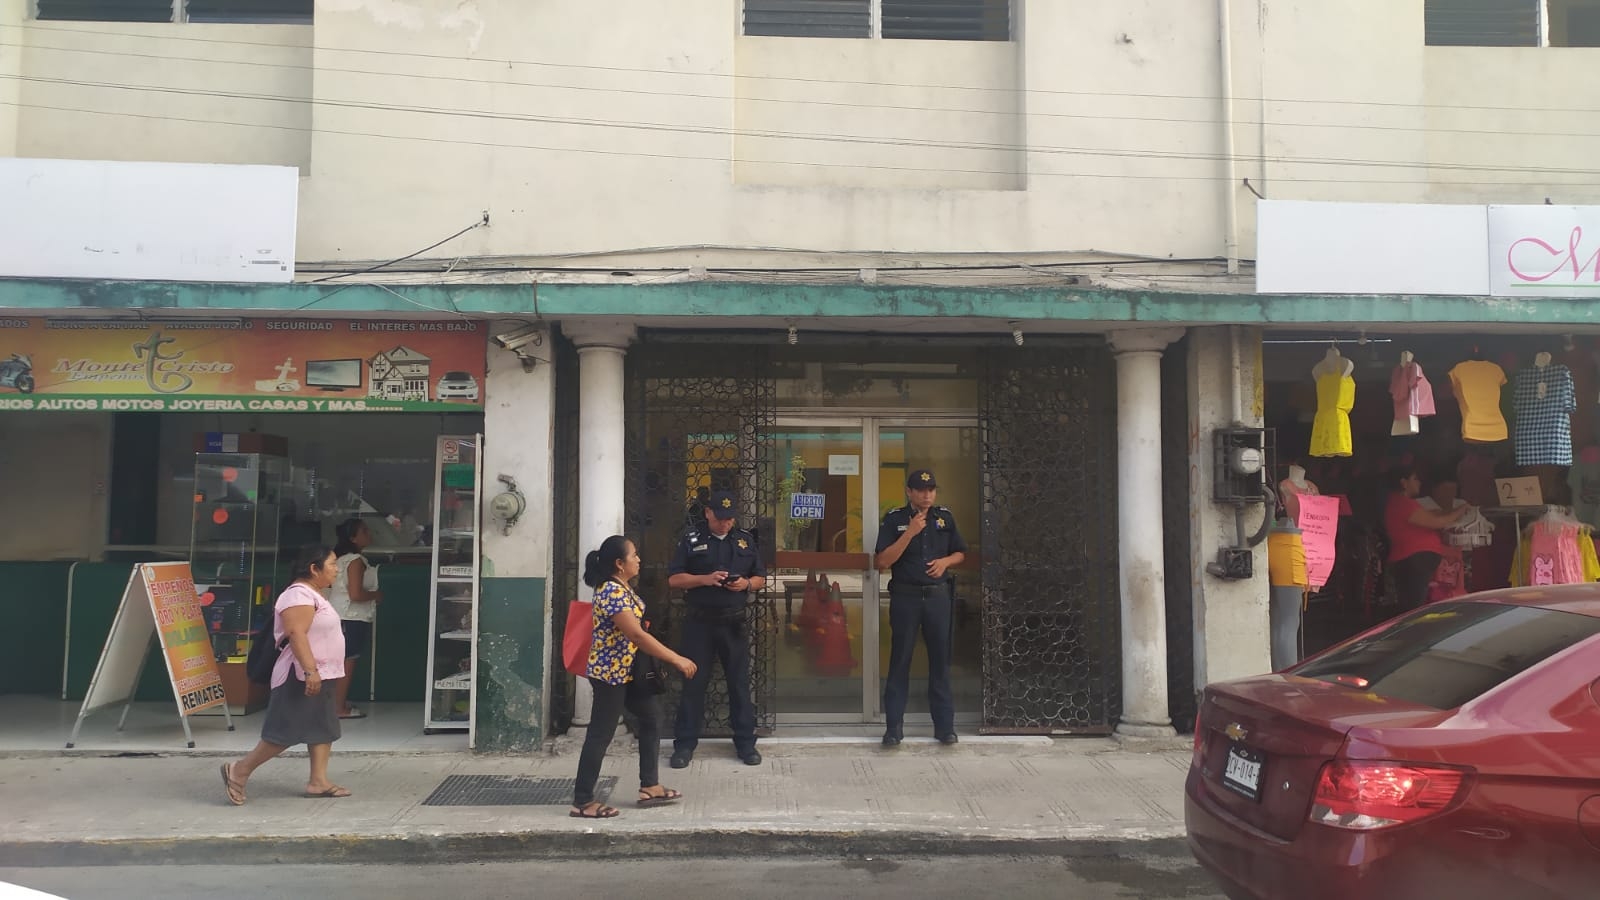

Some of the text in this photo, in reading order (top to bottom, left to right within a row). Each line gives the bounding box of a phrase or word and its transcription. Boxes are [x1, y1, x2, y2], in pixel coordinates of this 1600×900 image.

[350, 323, 476, 331] EL INTERES MAS BAJO
[52, 359, 234, 373] Monte Cristo
[37, 399, 98, 410] AUTOS
[102, 399, 165, 410] MOTOS
[168, 400, 245, 410] JOYERIA
[248, 400, 308, 410] CASAS
[312, 400, 325, 410] Y
[793, 495, 824, 506] ABIERTO
[793, 506, 823, 518] OPEN
[181, 683, 225, 711] REMATES
[1228, 756, 1260, 786] CV-014-
